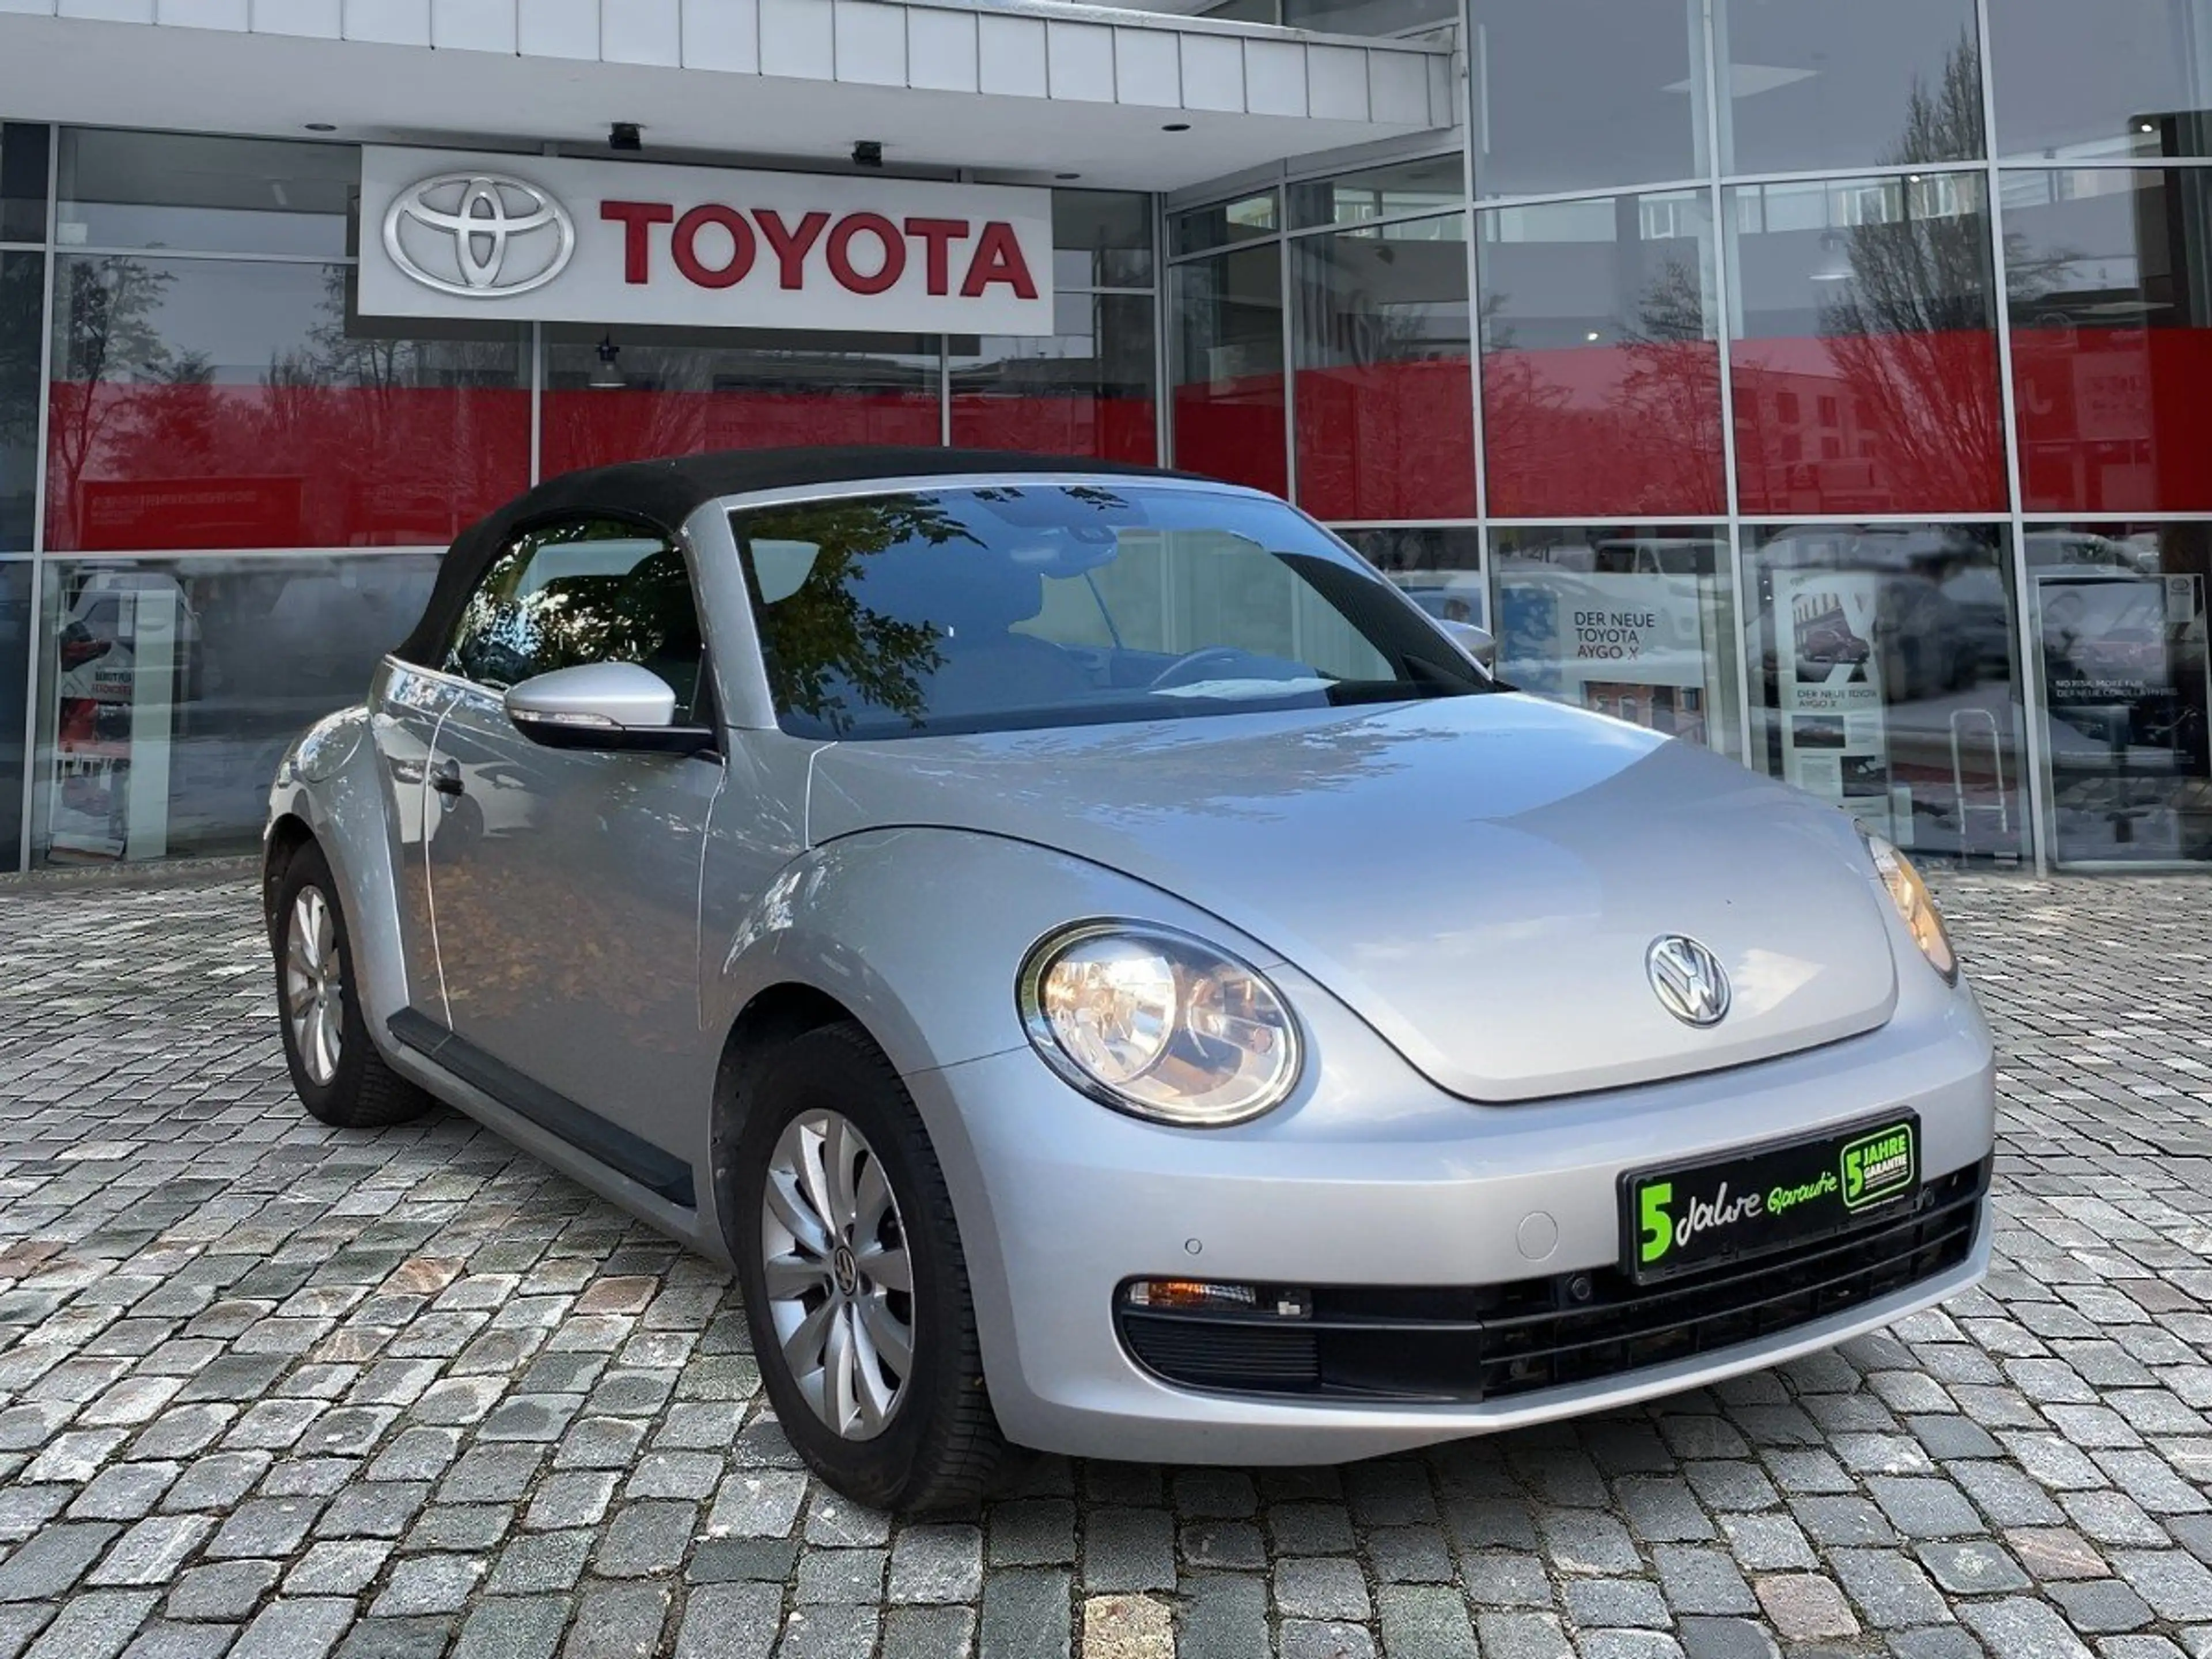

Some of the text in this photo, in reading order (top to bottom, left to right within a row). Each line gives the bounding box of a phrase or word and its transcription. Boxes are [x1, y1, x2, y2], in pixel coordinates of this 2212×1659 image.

[601, 200, 1037, 299] TOYOTA
[1575, 612, 1655, 627] DER NEUE
[1576, 628, 1639, 643] TOYOTA
[1578, 645, 1639, 660] AYGO X
[1847, 1150, 1862, 1198] 5
[1863, 1134, 1907, 1166] JAHRE
[1864, 1153, 1907, 1179] GARANTIE
[1642, 1183, 1672, 1262] 5
